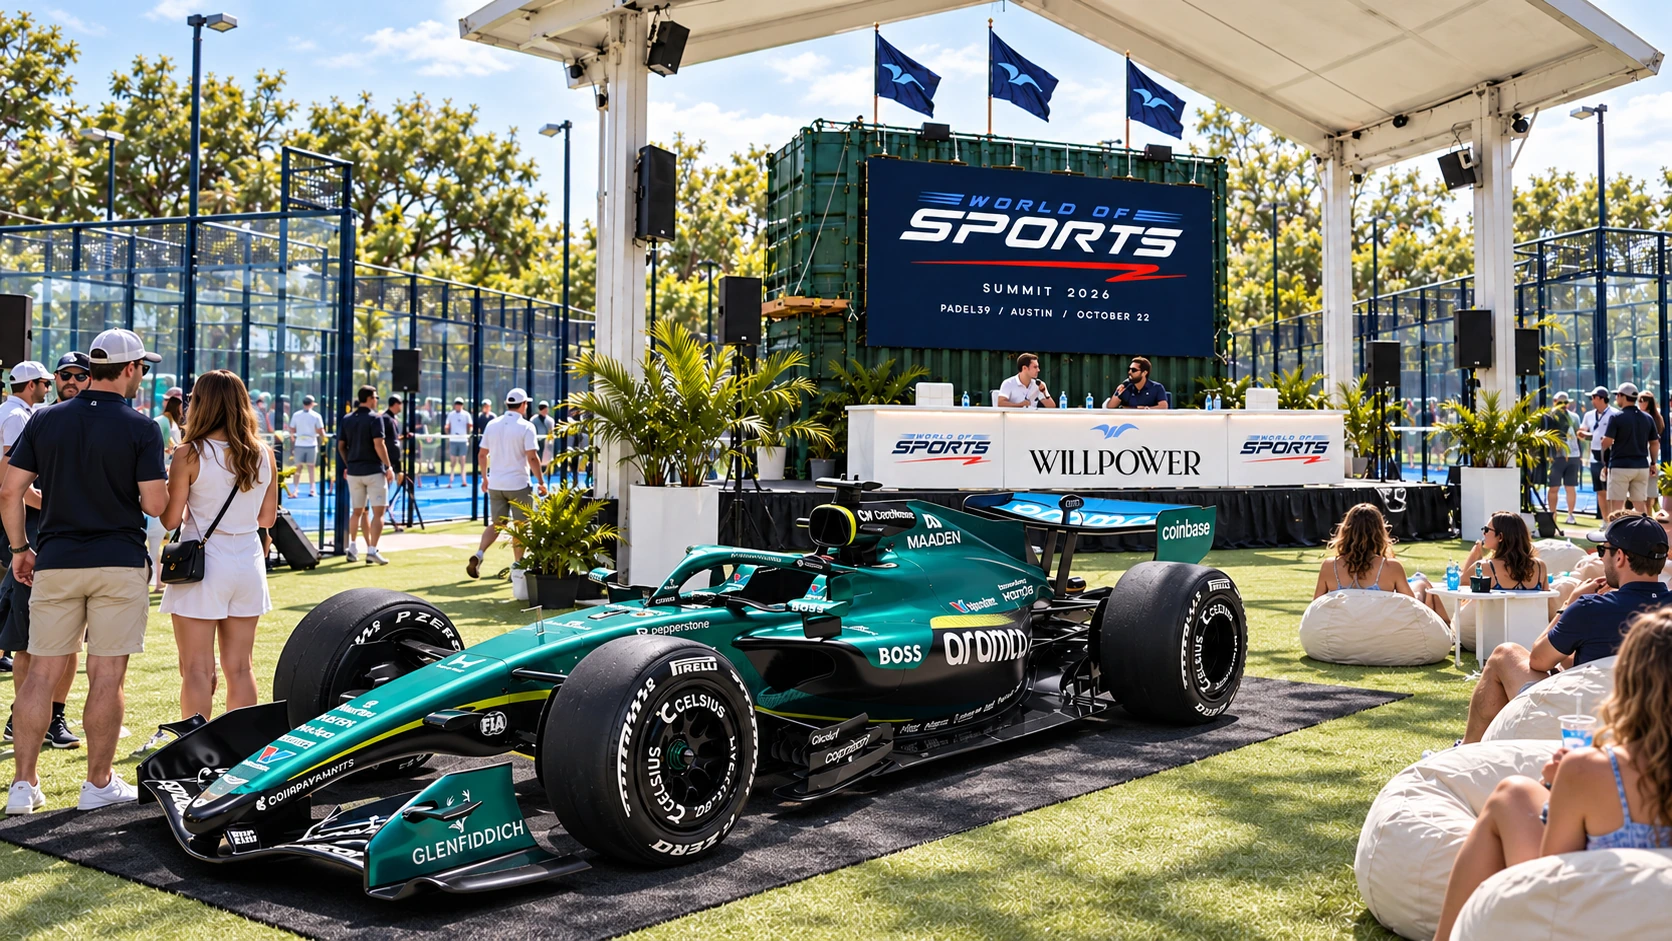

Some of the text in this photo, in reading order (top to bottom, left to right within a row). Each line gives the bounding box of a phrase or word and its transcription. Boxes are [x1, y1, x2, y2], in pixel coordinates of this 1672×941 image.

[969, 194, 1130, 219] WORLD OF
[899, 208, 1183, 258] SPORTS
[983, 283, 1110, 300] SUMMIT 2026
[940, 304, 991, 315] PADEL39
[1010, 307, 1053, 318] AUSTIN
[1077, 310, 1130, 321] OCTOBER
[1137, 313, 1150, 322] 22
[892, 440, 991, 454] SPORTS
[1240, 441, 1330, 454] SPORTS
[1029, 446, 1201, 476] WILLPOWER
[907, 530, 961, 549] MAADEN
[1162, 519, 1211, 541] coinbase
[652, 620, 710, 635] pepperstone
[878, 644, 922, 665] BOSS
[669, 656, 718, 677] PIRELLI
[674, 694, 726, 719] CELSIUS
[481, 715, 505, 732] FIA
[647, 746, 675, 812] CELSIUS
[412, 819, 525, 865] GLENFIDDICH
[650, 831, 720, 856] ZERO
